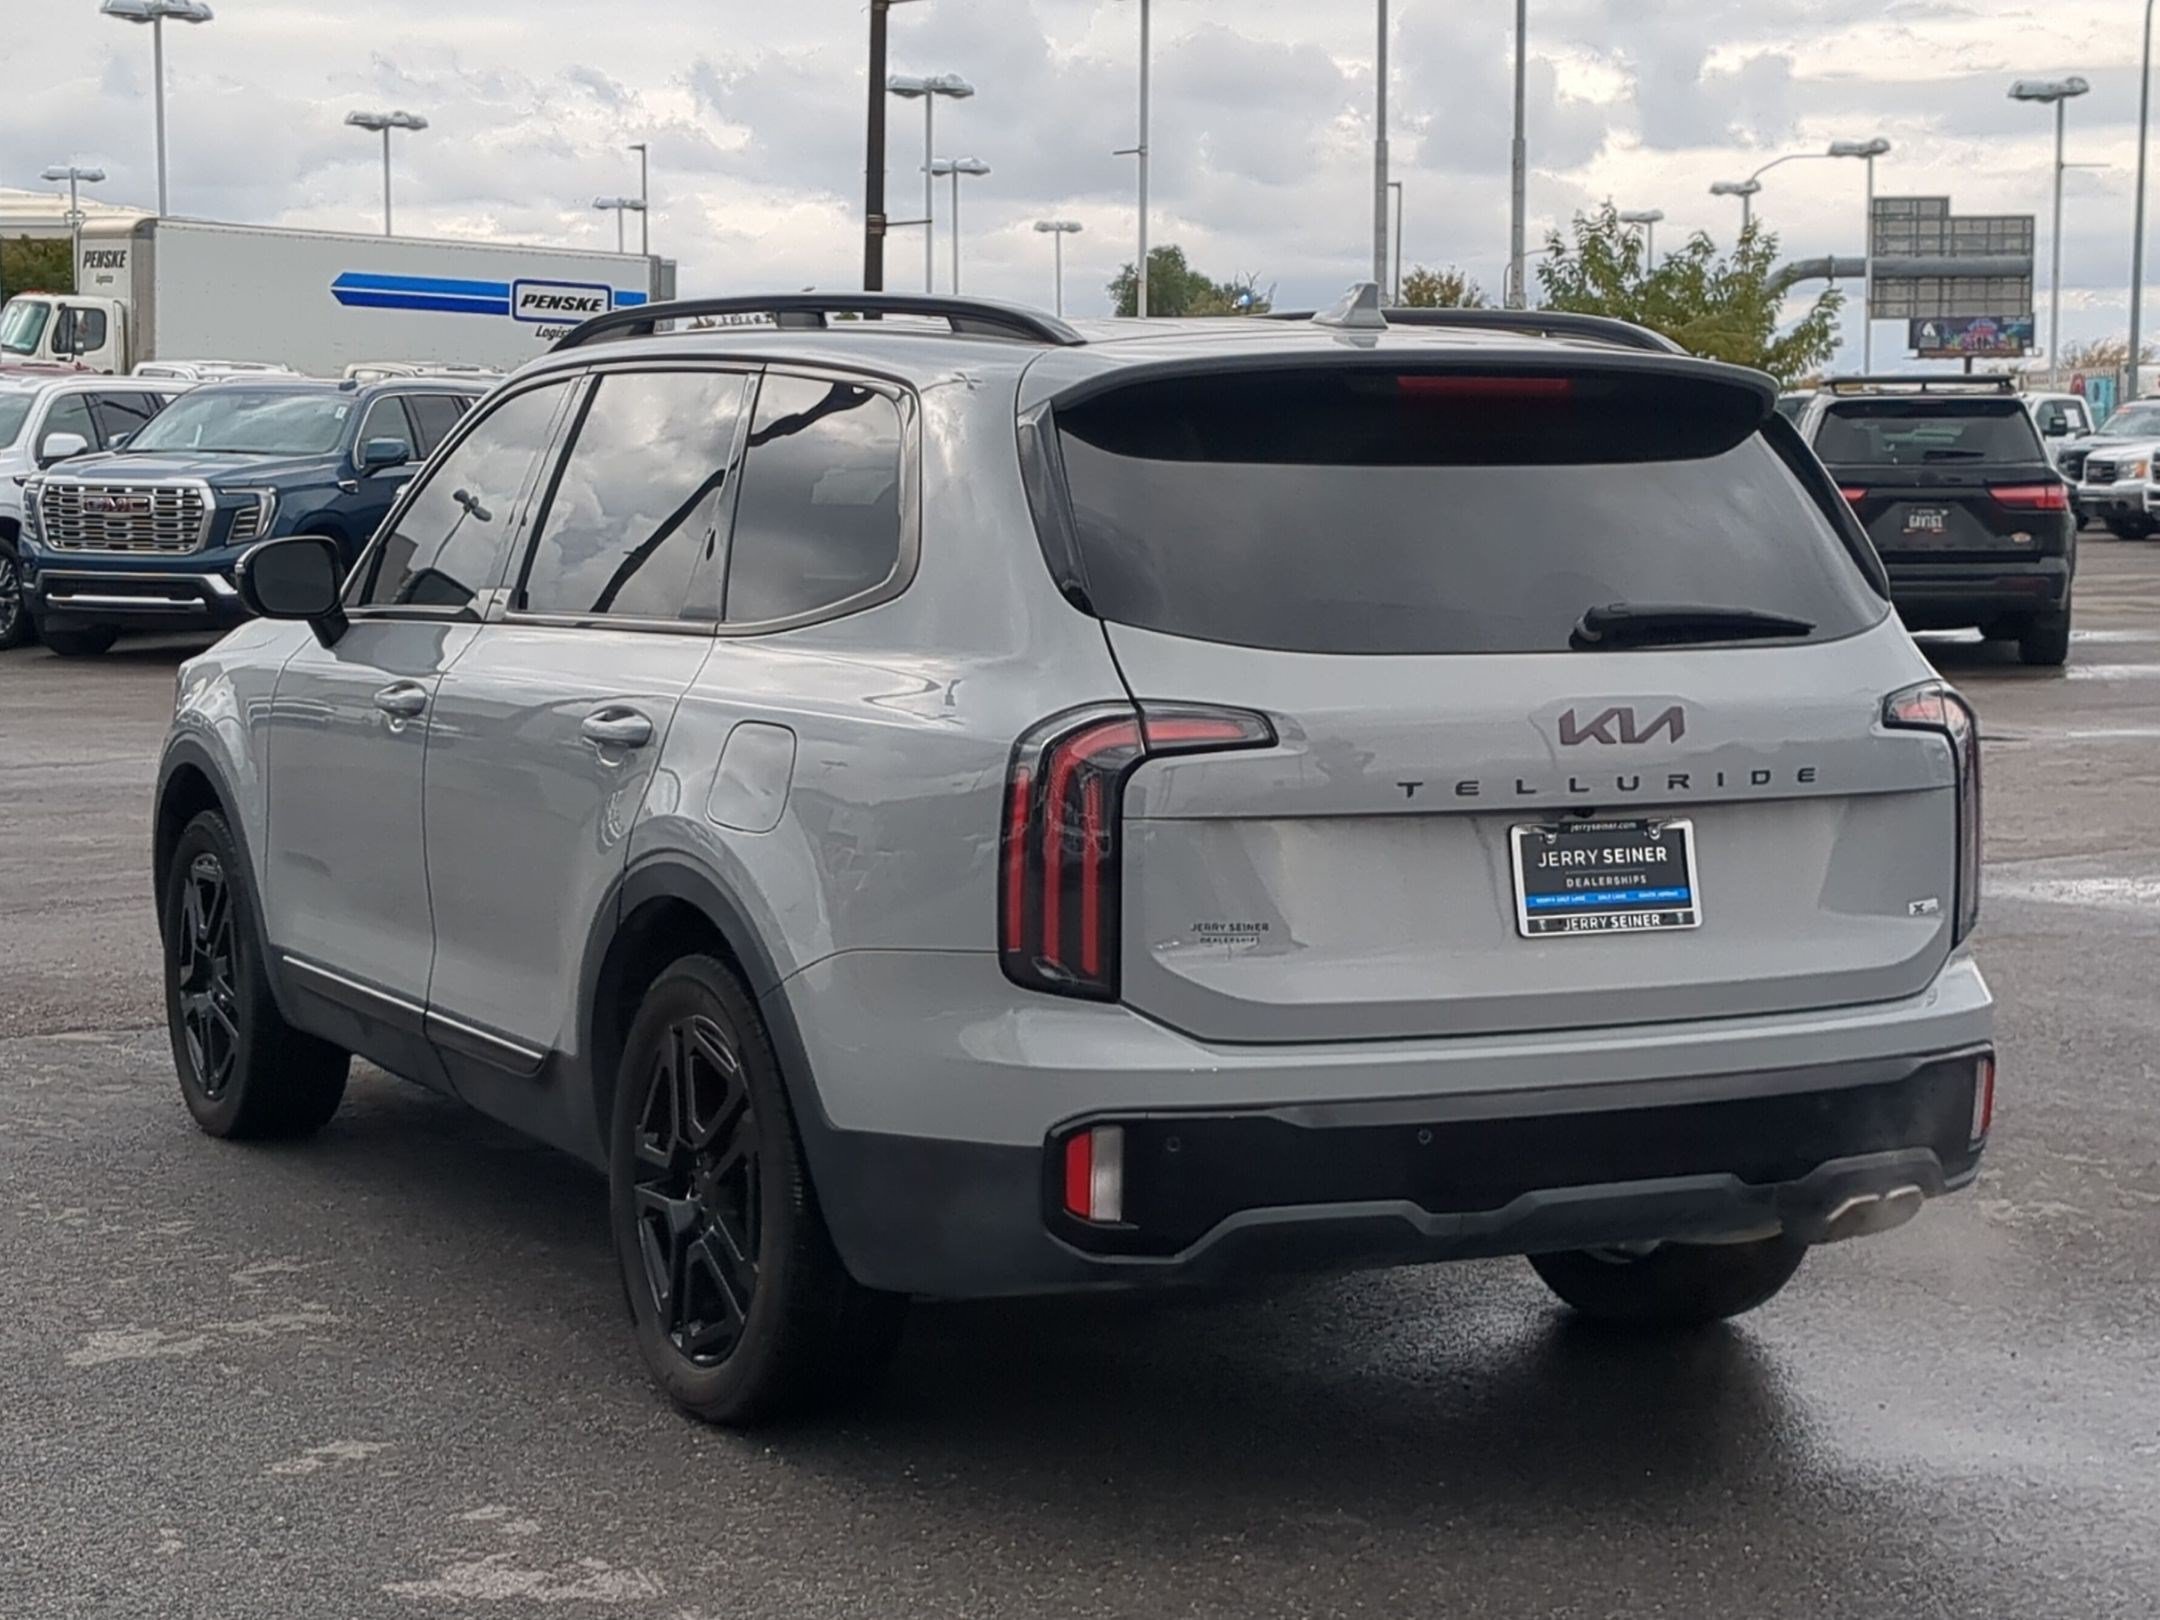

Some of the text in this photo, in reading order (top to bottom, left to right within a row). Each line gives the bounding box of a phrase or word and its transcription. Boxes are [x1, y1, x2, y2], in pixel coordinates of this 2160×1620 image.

[83, 250, 127, 269] PENSKE
[520, 293, 604, 312] PENSKE
[1558, 706, 1685, 745] KIA
[1397, 767, 1817, 799] TELLURIDE
[1538, 846, 1668, 868] JERRY SEINER
[1566, 875, 1647, 888] DEALERSHIPS
[1191, 922, 1269, 932] JERRY SEINER
[1564, 914, 1661, 931] JERRY SEINER
